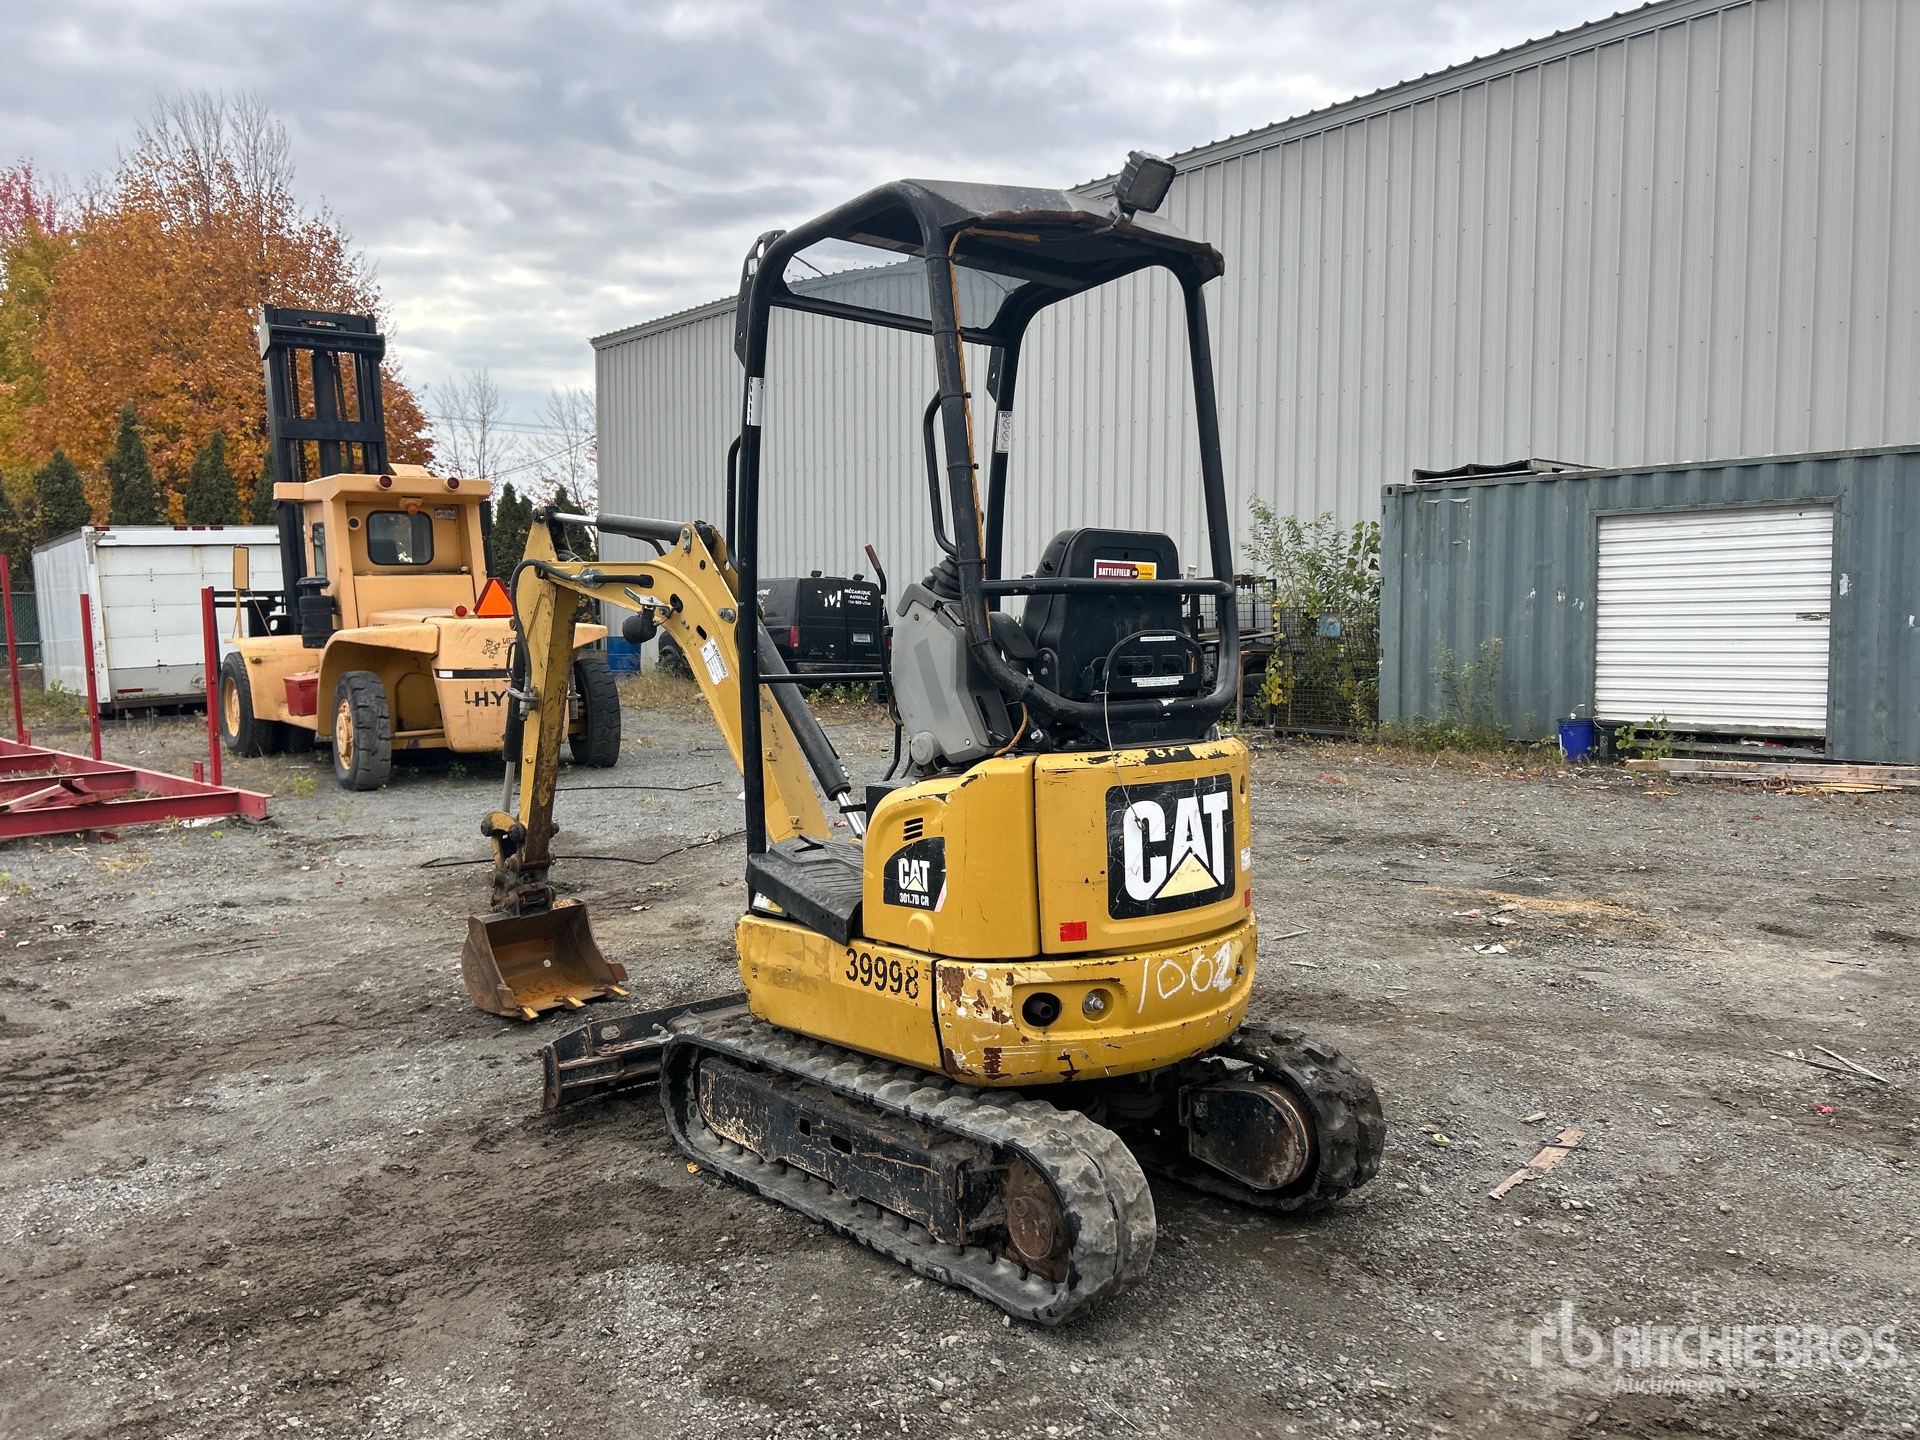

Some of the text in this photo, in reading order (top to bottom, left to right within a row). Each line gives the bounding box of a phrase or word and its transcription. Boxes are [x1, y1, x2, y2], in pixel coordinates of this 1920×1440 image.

[1098, 567, 1130, 577] BATTLEFIELD
[474, 690, 510, 707] HY
[1123, 790, 1229, 901] CAT
[897, 857, 931, 893] CAT
[920, 895, 930, 907] CR
[845, 947, 919, 1000] 39998
